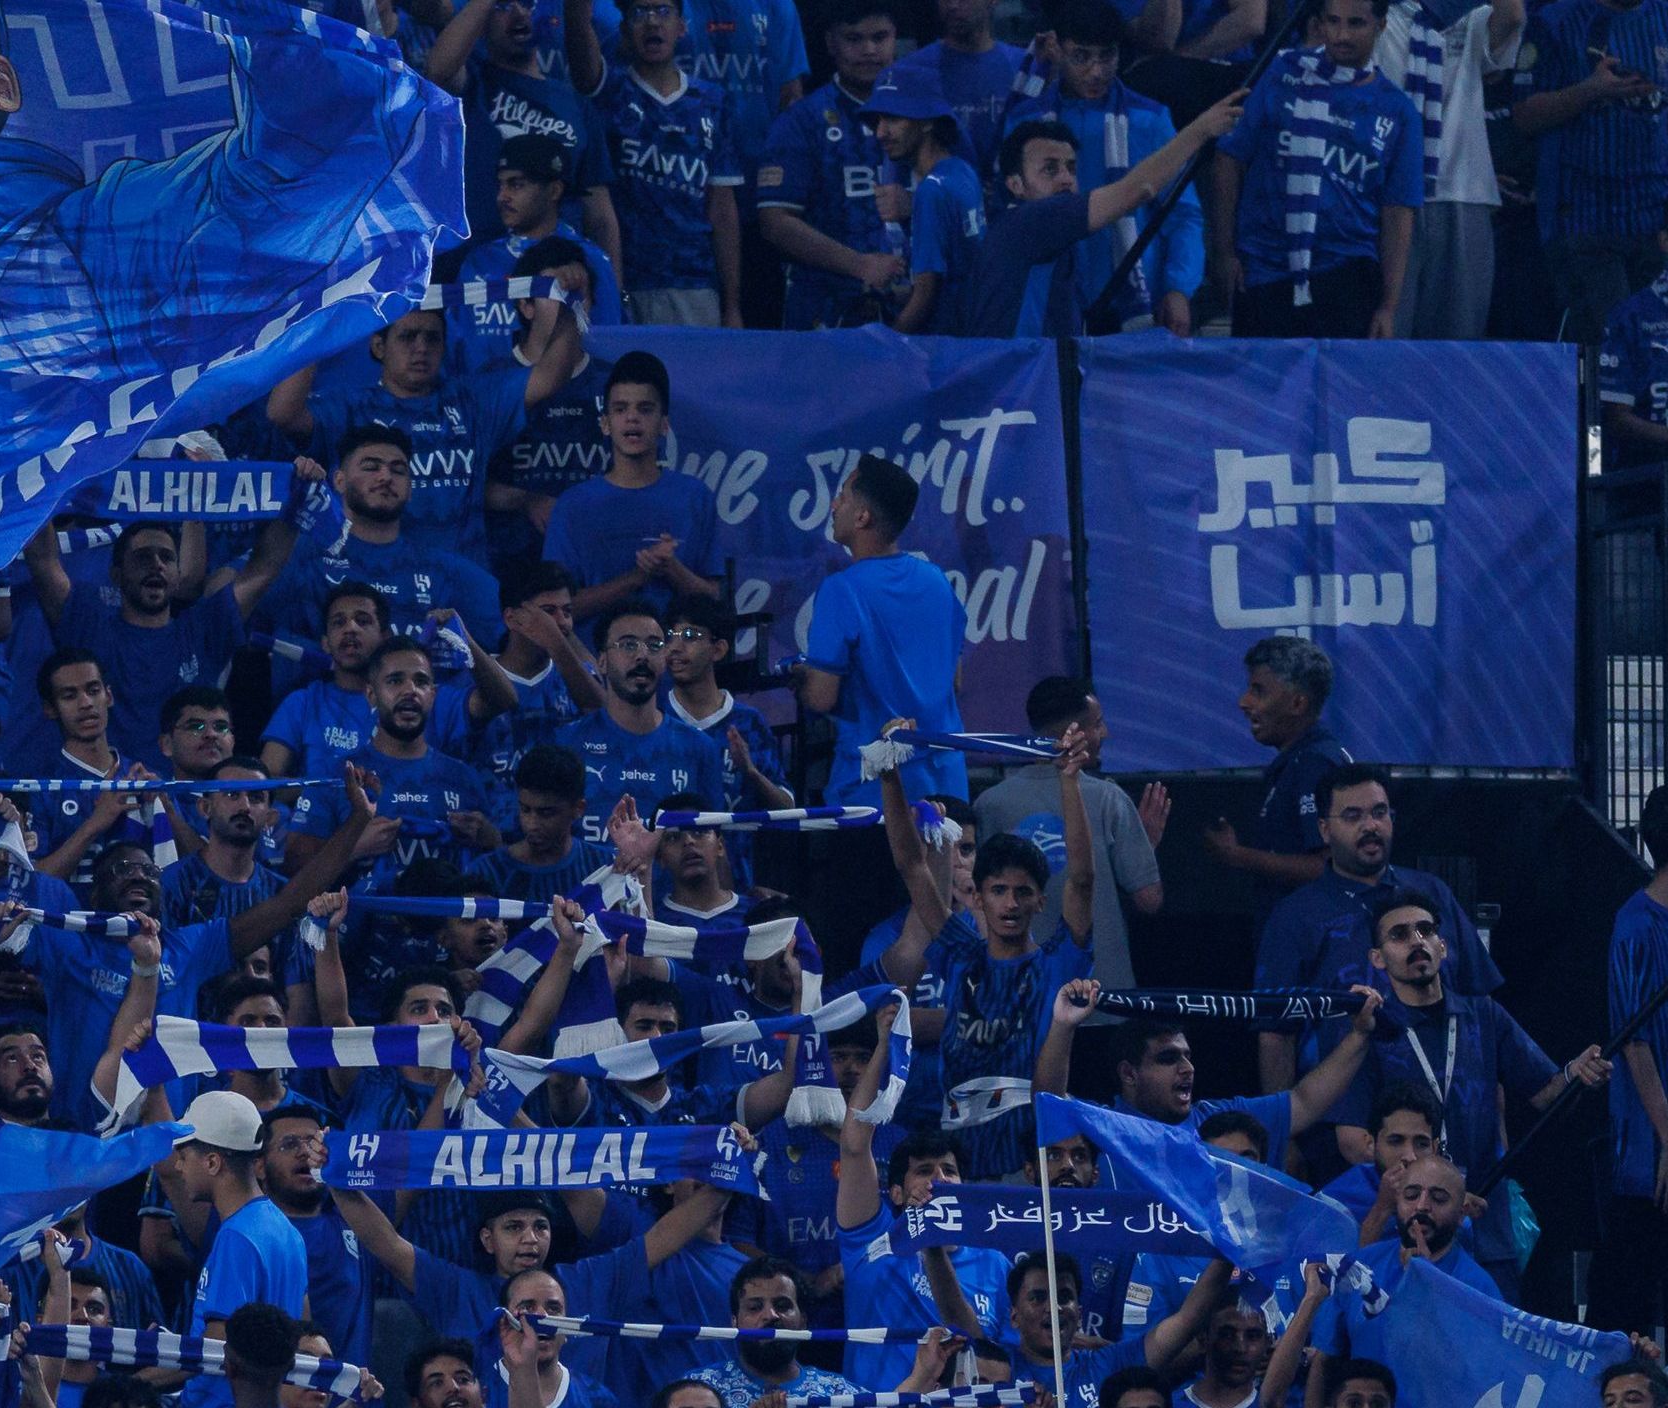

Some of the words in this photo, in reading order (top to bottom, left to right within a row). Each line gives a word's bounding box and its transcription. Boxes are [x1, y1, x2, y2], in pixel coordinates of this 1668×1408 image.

[1278, 131, 1379, 176] SVVY
[513, 442, 611, 471] SAVVY
[1198, 414, 1445, 533] كبير
[108, 470, 283, 513] ALHILAL
[431, 1132, 656, 1187] ALHILAL
